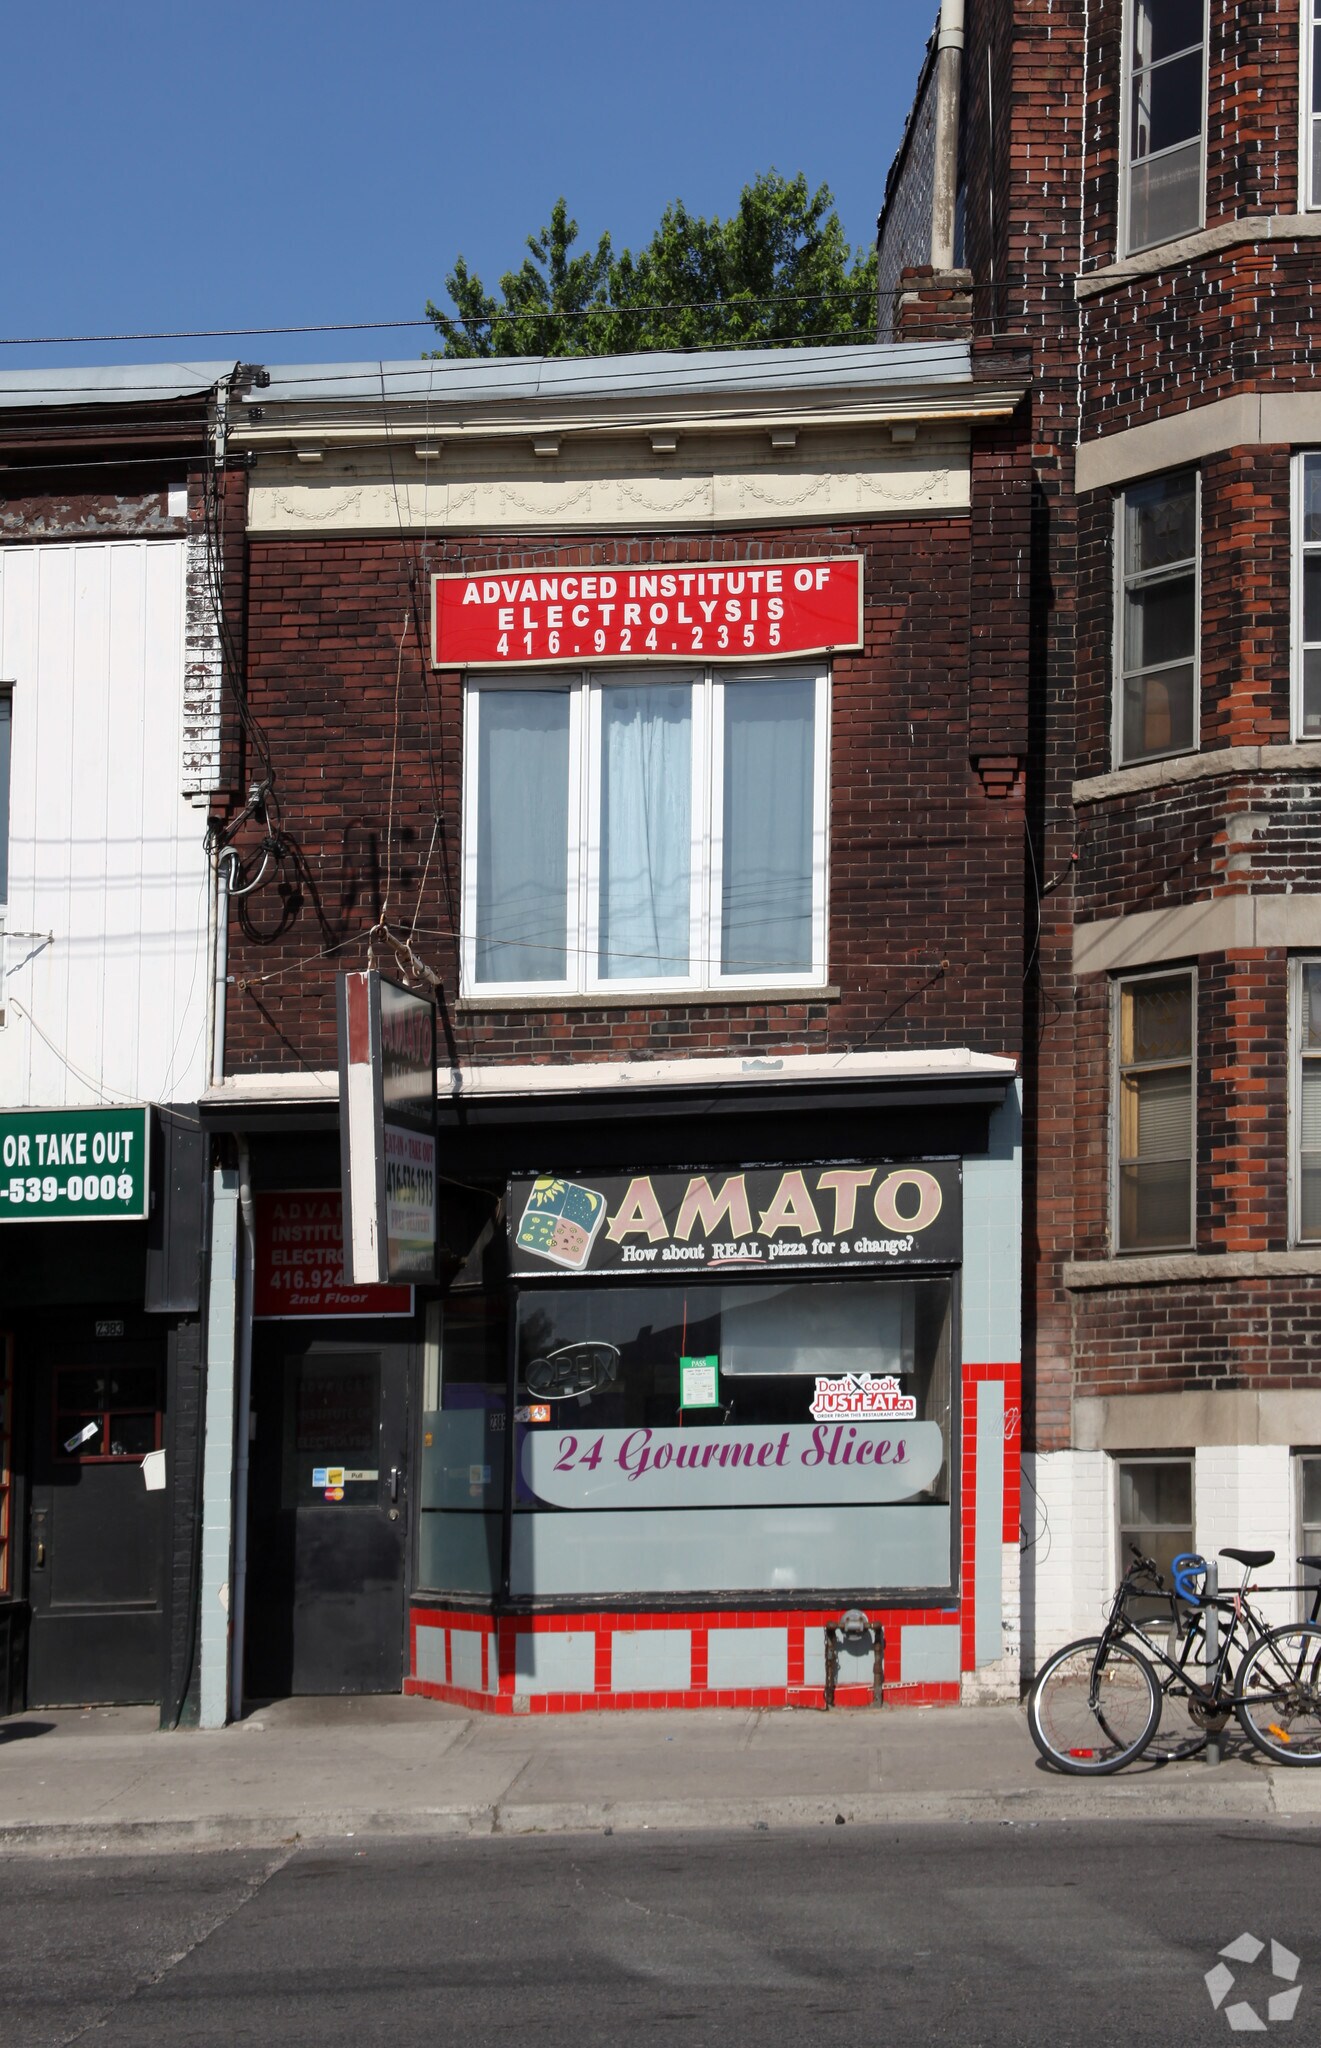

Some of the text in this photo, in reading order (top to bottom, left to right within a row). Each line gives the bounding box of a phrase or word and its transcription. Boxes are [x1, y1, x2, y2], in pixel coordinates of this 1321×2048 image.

[462, 568, 832, 605] ADVANCED INSTITUTE OF
[498, 597, 785, 631] ELECTROLYSIS
[496, 623, 781, 656] 416.924.2355
[381, 1008, 432, 1067] AMATO
[3, 1131, 134, 1167] OR TAKE OUT
[408, 1139, 421, 1160] TAKE
[423, 1142, 433, 1163] OUT
[604, 1167, 943, 1243] AMATO
[621, 1235, 914, 1262] How about REAL pizza for a change?
[289, 1291, 368, 1305] 2nd Floor
[96, 1321, 123, 1336] 2383
[525, 1350, 617, 1389] OPEN
[691, 1359, 706, 1368] PASS
[819, 1379, 897, 1392] Don't cook
[553, 1424, 910, 1482] 24 Gourmet Slices
